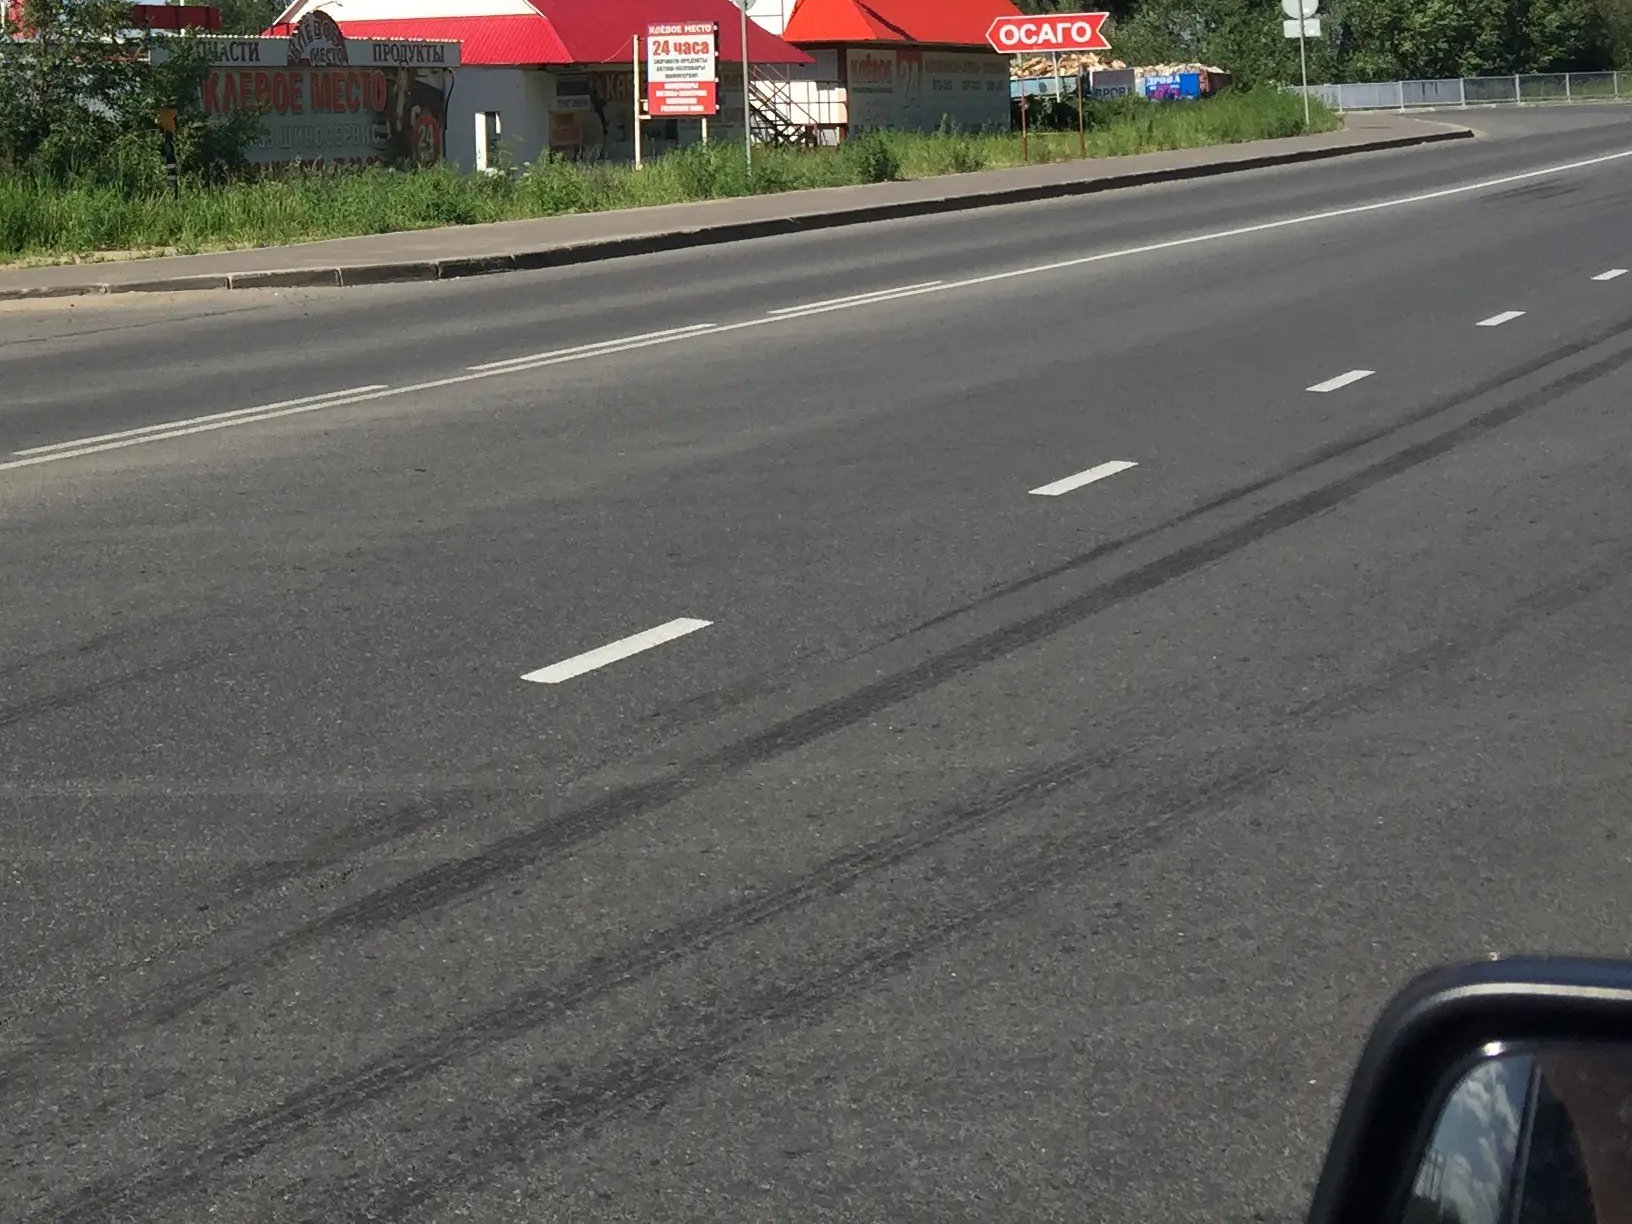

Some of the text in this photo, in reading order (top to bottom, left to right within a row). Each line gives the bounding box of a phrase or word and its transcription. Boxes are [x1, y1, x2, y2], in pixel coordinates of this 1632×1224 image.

[684, 23, 712, 33] МЕСТО
[998, 21, 1092, 46] ОСАГО
[372, 42, 445, 64] ПРОДУКТЫ
[652, 40, 709, 56] 24 часа
[309, 70, 388, 113] МЕСТО
[418, 124, 434, 148] 24
